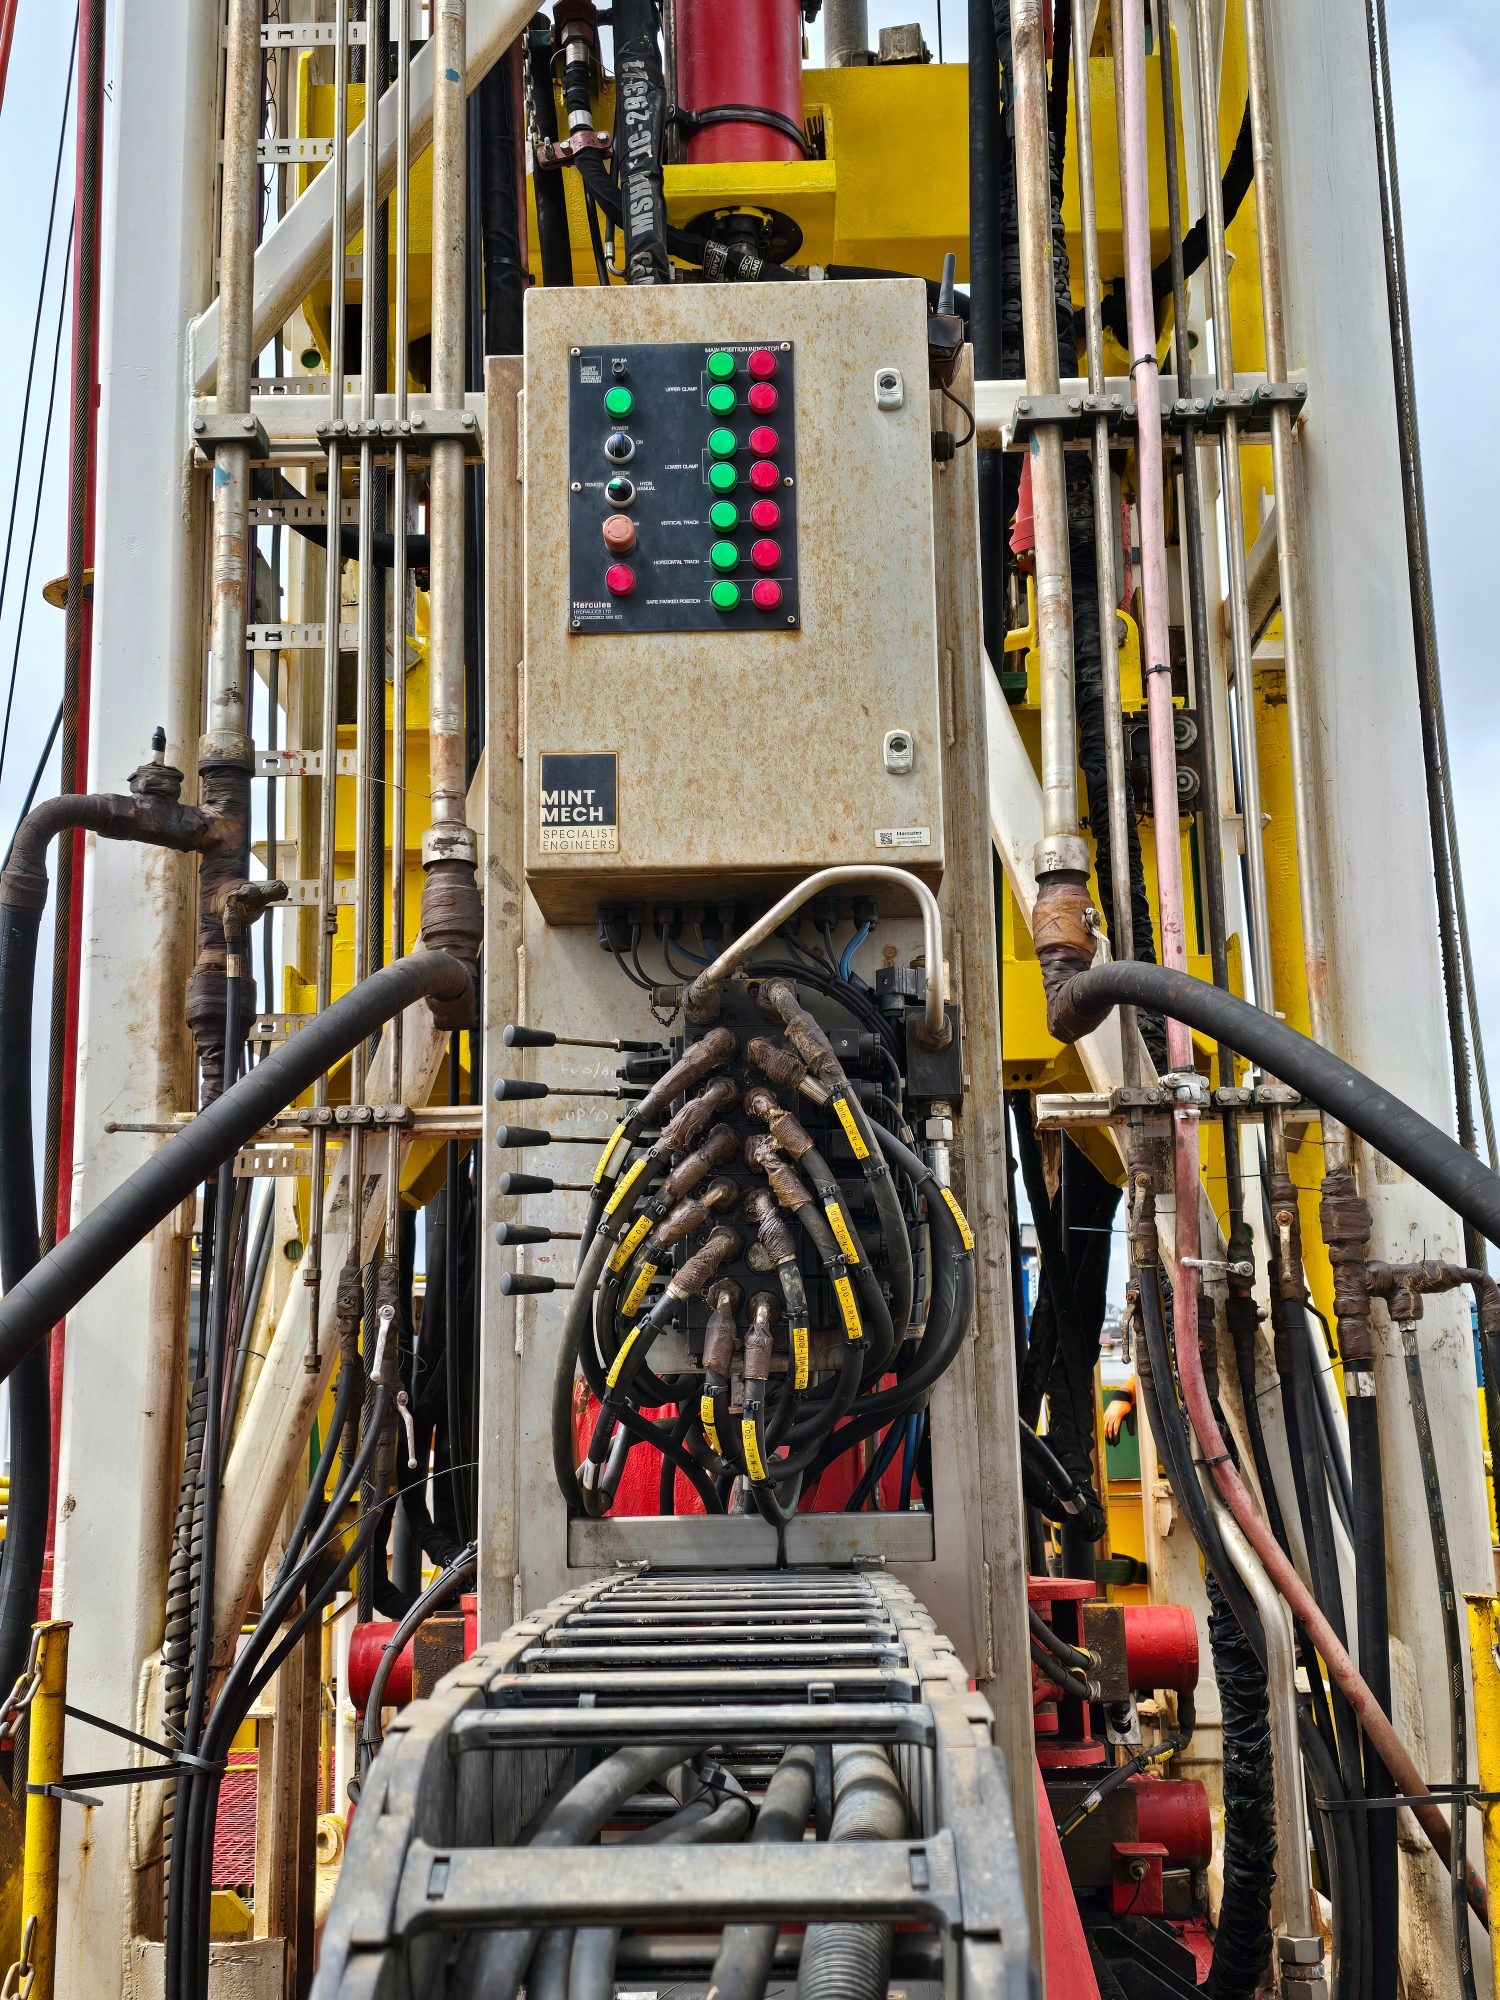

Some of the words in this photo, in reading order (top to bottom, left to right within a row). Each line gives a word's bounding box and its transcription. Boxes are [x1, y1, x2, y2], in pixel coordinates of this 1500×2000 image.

[572, 601, 612, 609] Hercules
[541, 789, 596, 806] MINT
[541, 806, 604, 823] MECH
[543, 828, 616, 840] SPECIALIST
[543, 839, 616, 851] ENGINEERS
